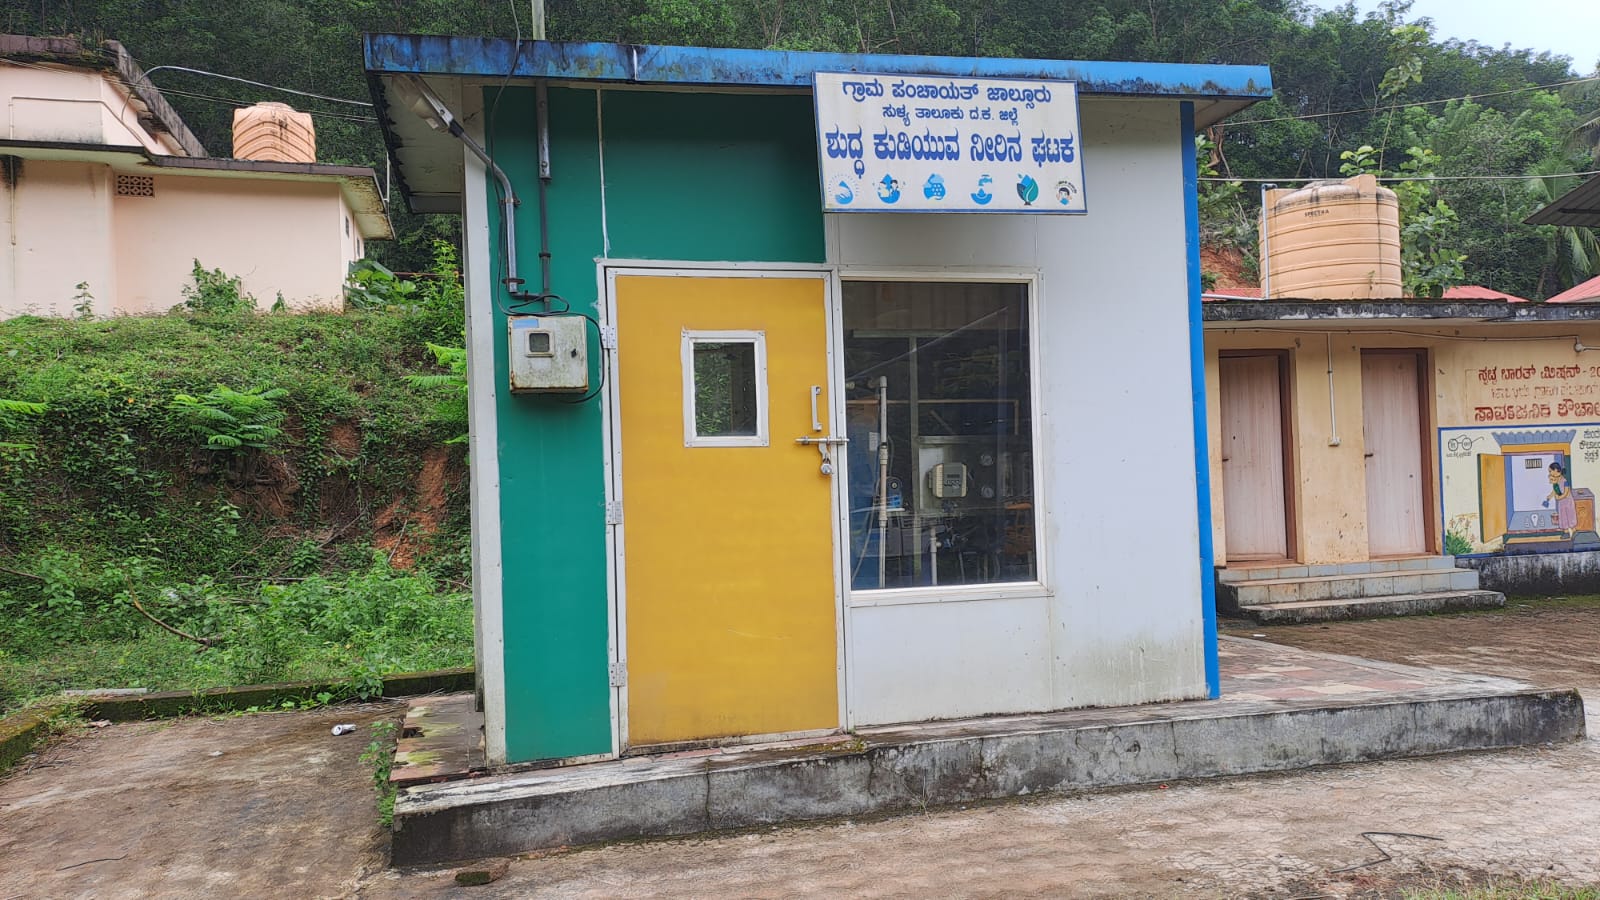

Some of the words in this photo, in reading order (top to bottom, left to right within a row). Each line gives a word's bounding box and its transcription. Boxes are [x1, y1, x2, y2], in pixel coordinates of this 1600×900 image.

[842, 78, 884, 102] ಗ್ರಾಮ
[891, 80, 979, 101] ಪಂಚಾಯತ್
[986, 85, 1051, 109] ಜಾಲ್ಸೂರು
[882, 104, 911, 126] ಸುಳ್ಯ
[915, 106, 964, 120] ತಾಲೂಕು
[999, 107, 1019, 126] ಜಿಲ್ಲೆ
[825, 124, 866, 179] ಶುದ್ಧ
[872, 125, 961, 161] ಕುಡಿಯುವ
[970, 128, 1023, 162] ನೀರಿನ
[1031, 129, 1075, 168] ಘಟಕ
